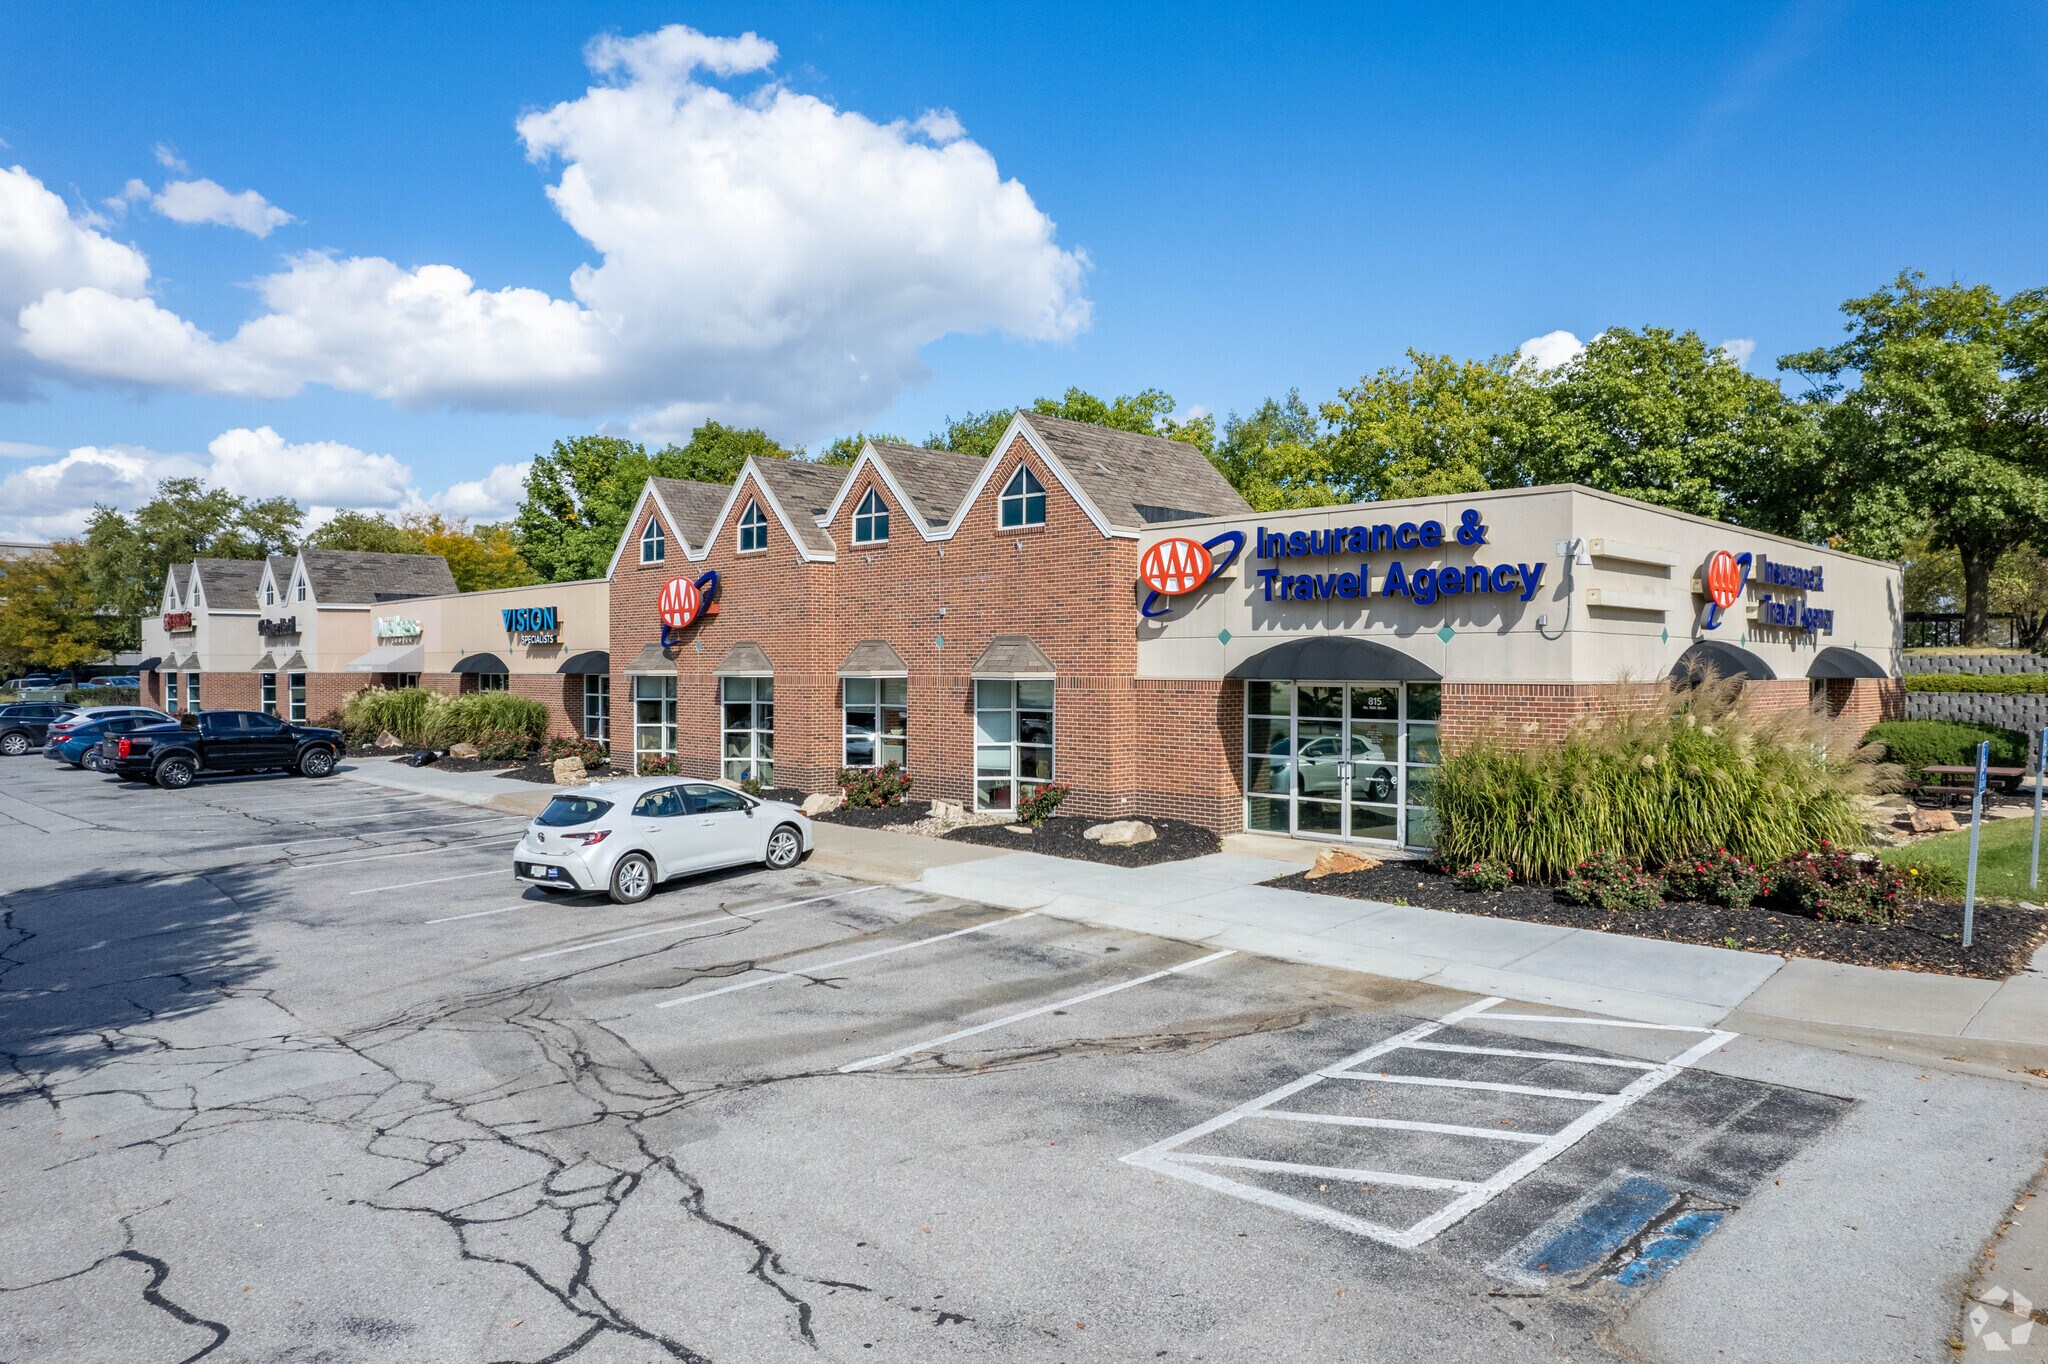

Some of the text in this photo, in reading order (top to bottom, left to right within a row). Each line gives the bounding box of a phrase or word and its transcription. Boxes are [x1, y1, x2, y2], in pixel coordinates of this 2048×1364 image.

[1257, 508, 1488, 559] Insurance &
[1144, 540, 1206, 593] AAA
[1257, 561, 1545, 606] Travel Agency
[502, 606, 555, 632] VISION
[660, 578, 696, 626] AAA
[521, 634, 554, 644] SPECIALISTS
[1368, 697, 1382, 706] 815
